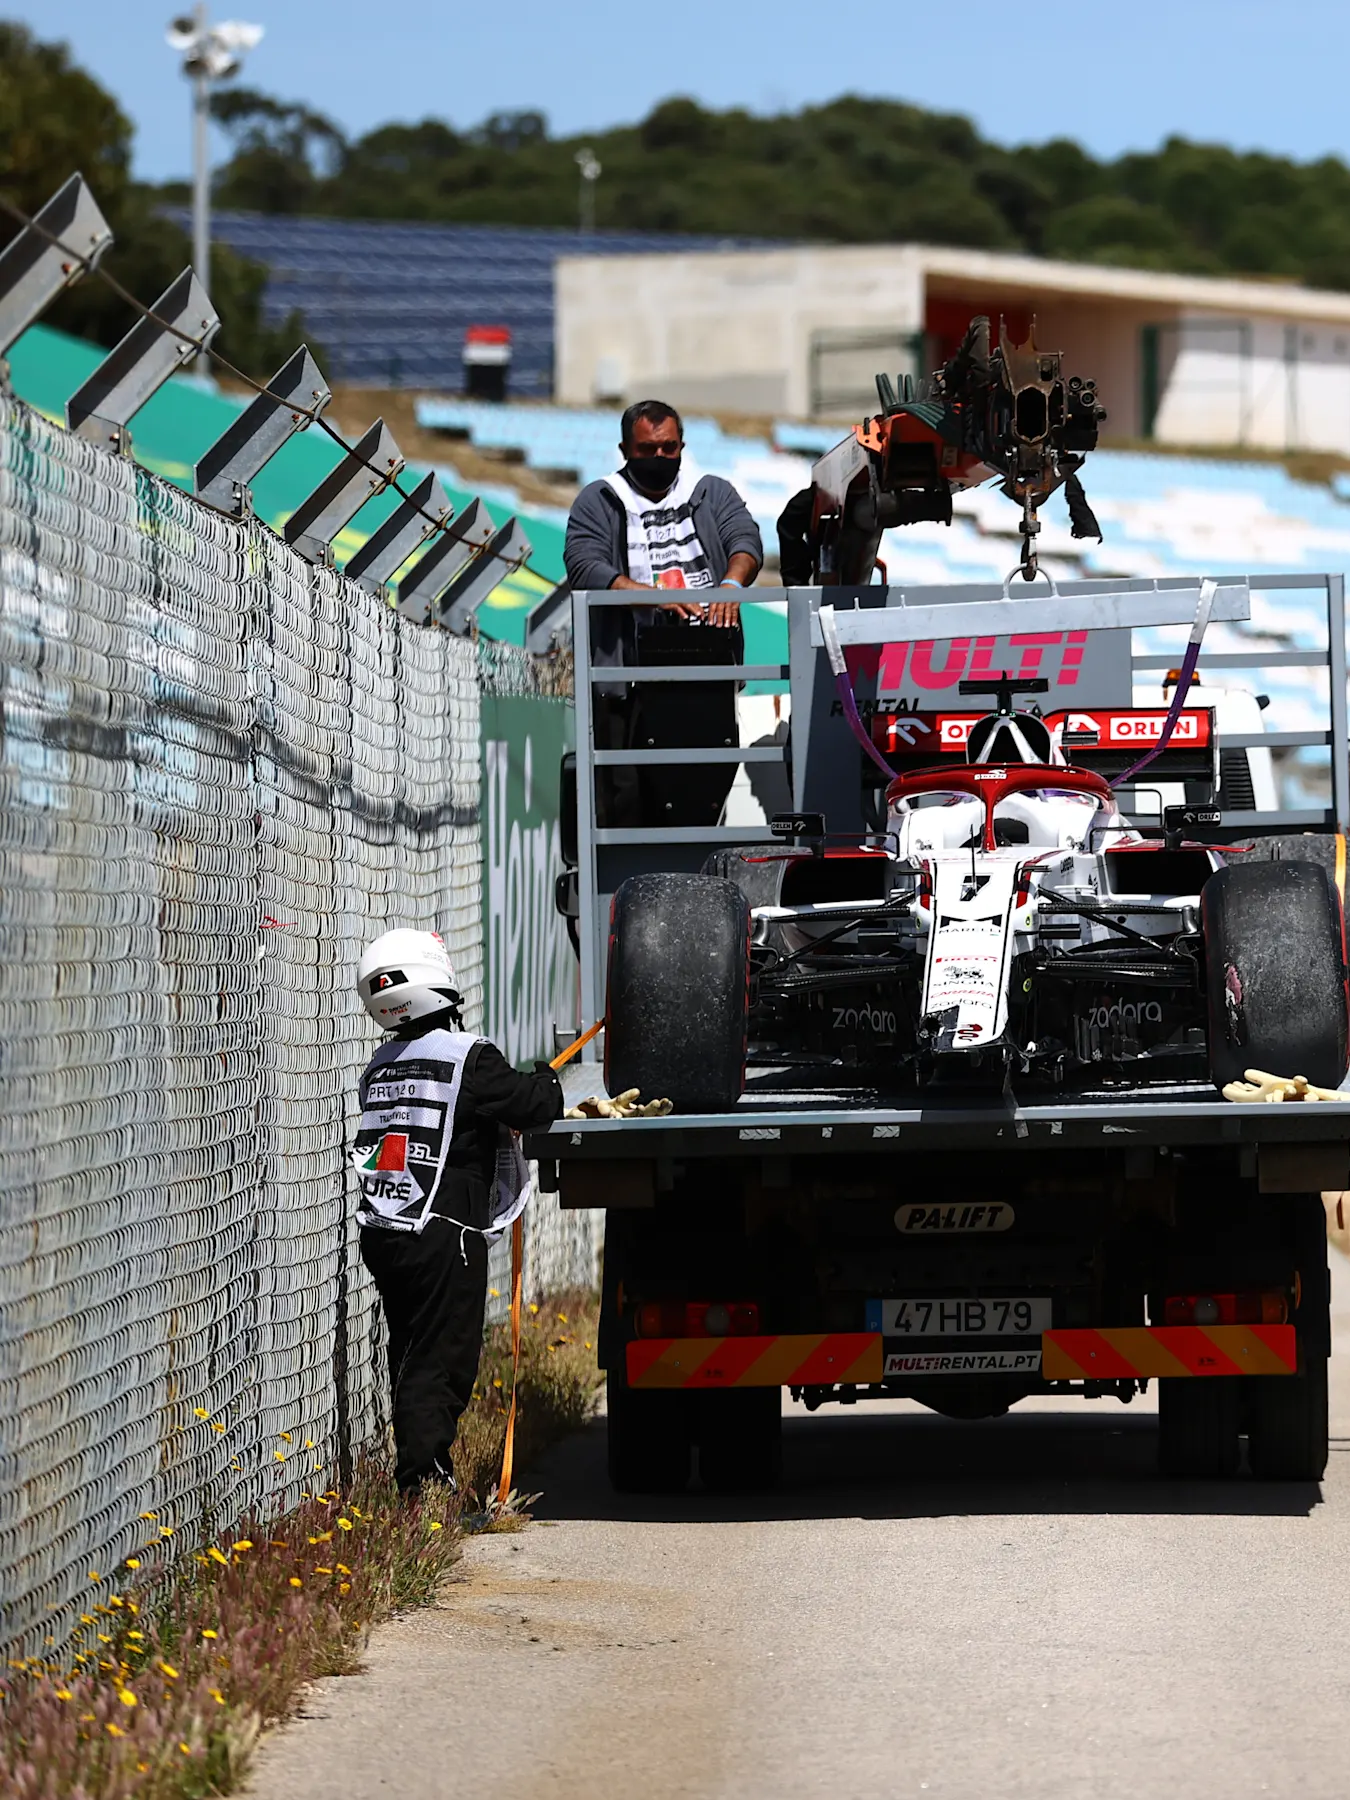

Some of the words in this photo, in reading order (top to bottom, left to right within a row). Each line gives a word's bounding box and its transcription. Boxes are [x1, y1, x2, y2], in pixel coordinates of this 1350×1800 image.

[837, 631, 1088, 691] MULTI
[1116, 721, 1190, 736] ORLN
[369, 1085, 392, 1099] PRT
[888, 1354, 1038, 1371] MULTIRENTAL.PT
